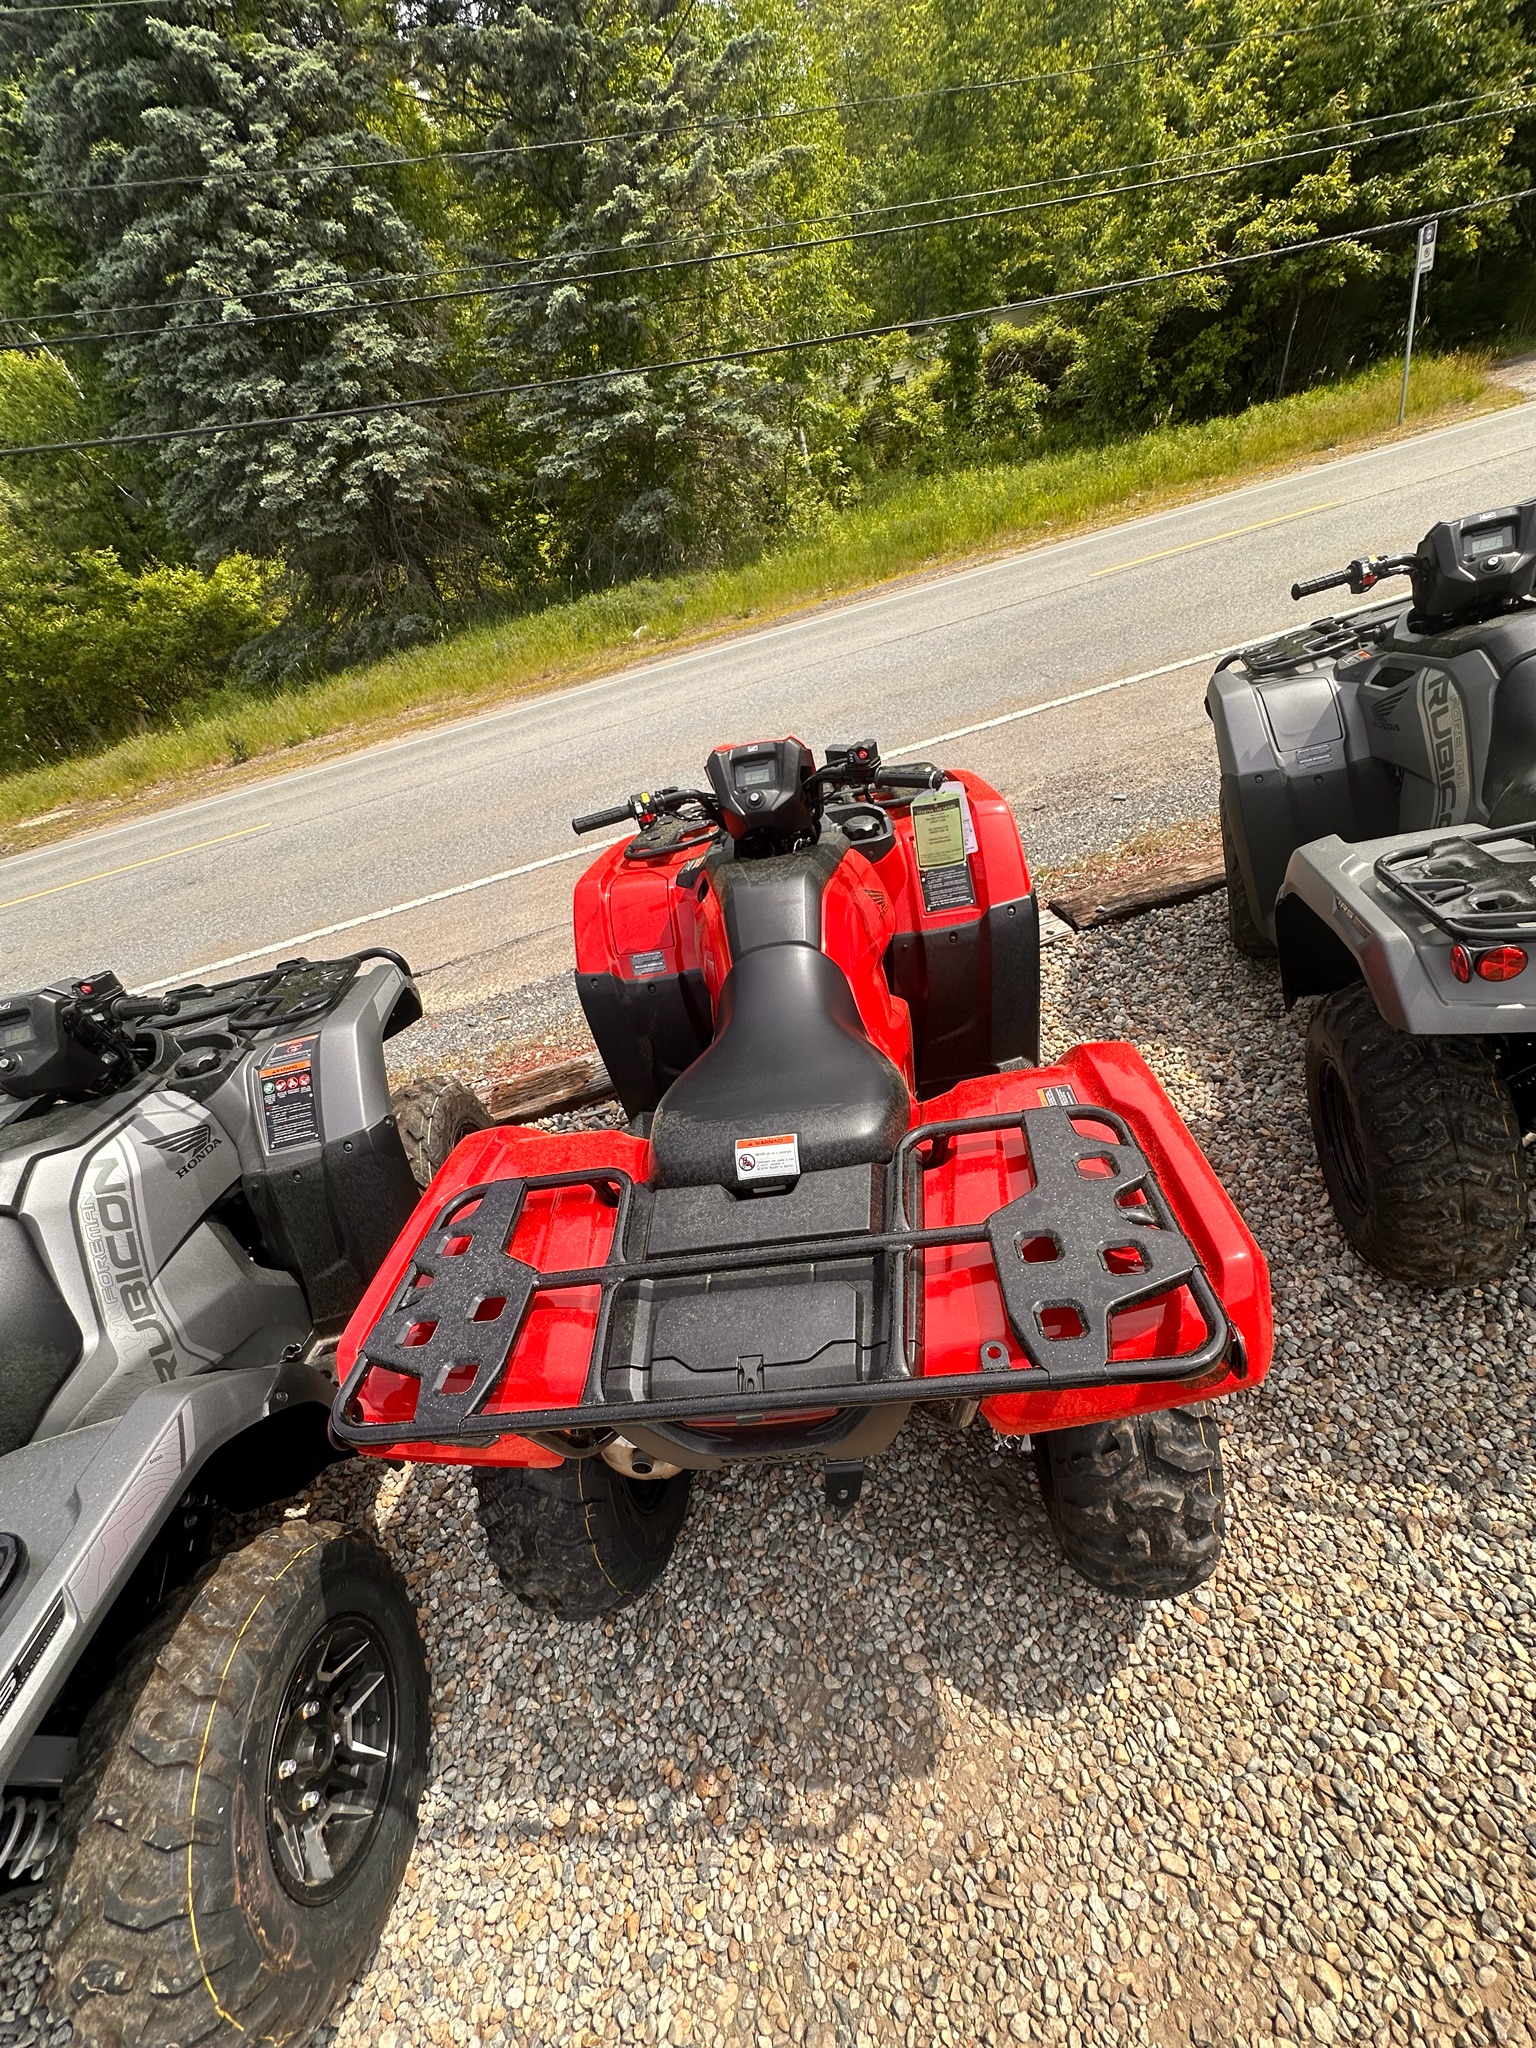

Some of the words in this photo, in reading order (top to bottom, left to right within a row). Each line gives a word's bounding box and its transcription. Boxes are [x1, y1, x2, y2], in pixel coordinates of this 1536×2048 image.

[1450, 694, 1465, 788] FOREMAN
[174, 1138, 224, 1179] HONDA
[755, 1138, 784, 1147] WARNING
[80, 1191, 119, 1305] FOREMAN
[89, 1157, 178, 1384] RUBICON
